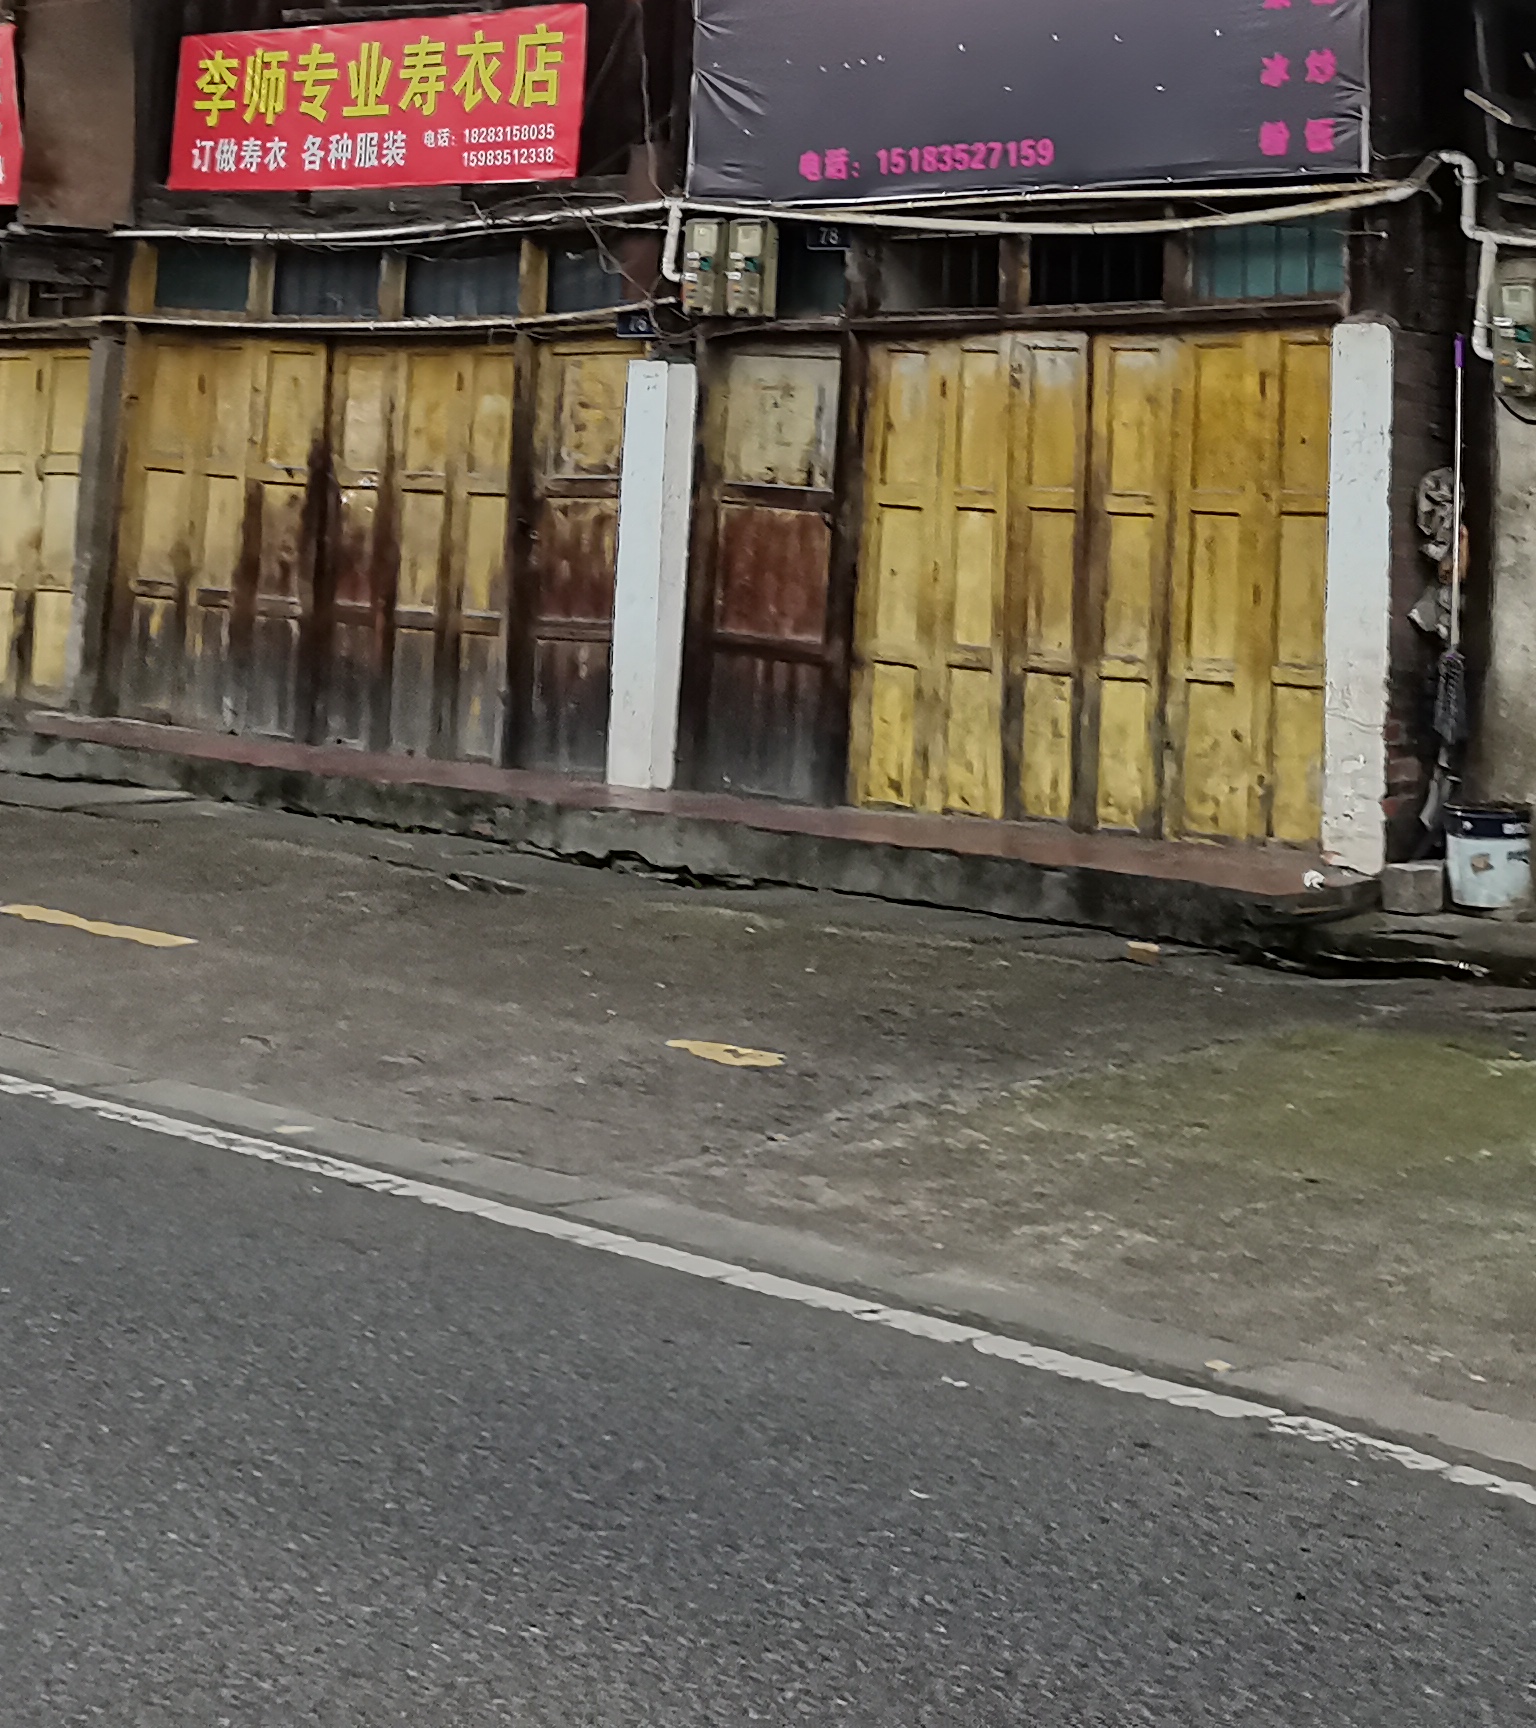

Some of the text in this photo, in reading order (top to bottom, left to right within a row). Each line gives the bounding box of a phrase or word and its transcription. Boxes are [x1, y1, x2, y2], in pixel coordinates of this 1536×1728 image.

[193, 23, 565, 128] 李师专业寿衣店
[191, 131, 407, 173] 订做寿衣 各种服装
[463, 123, 555, 144] 18283158035
[462, 146, 554, 167] 15983512338
[876, 138, 1055, 175] 15183527159
